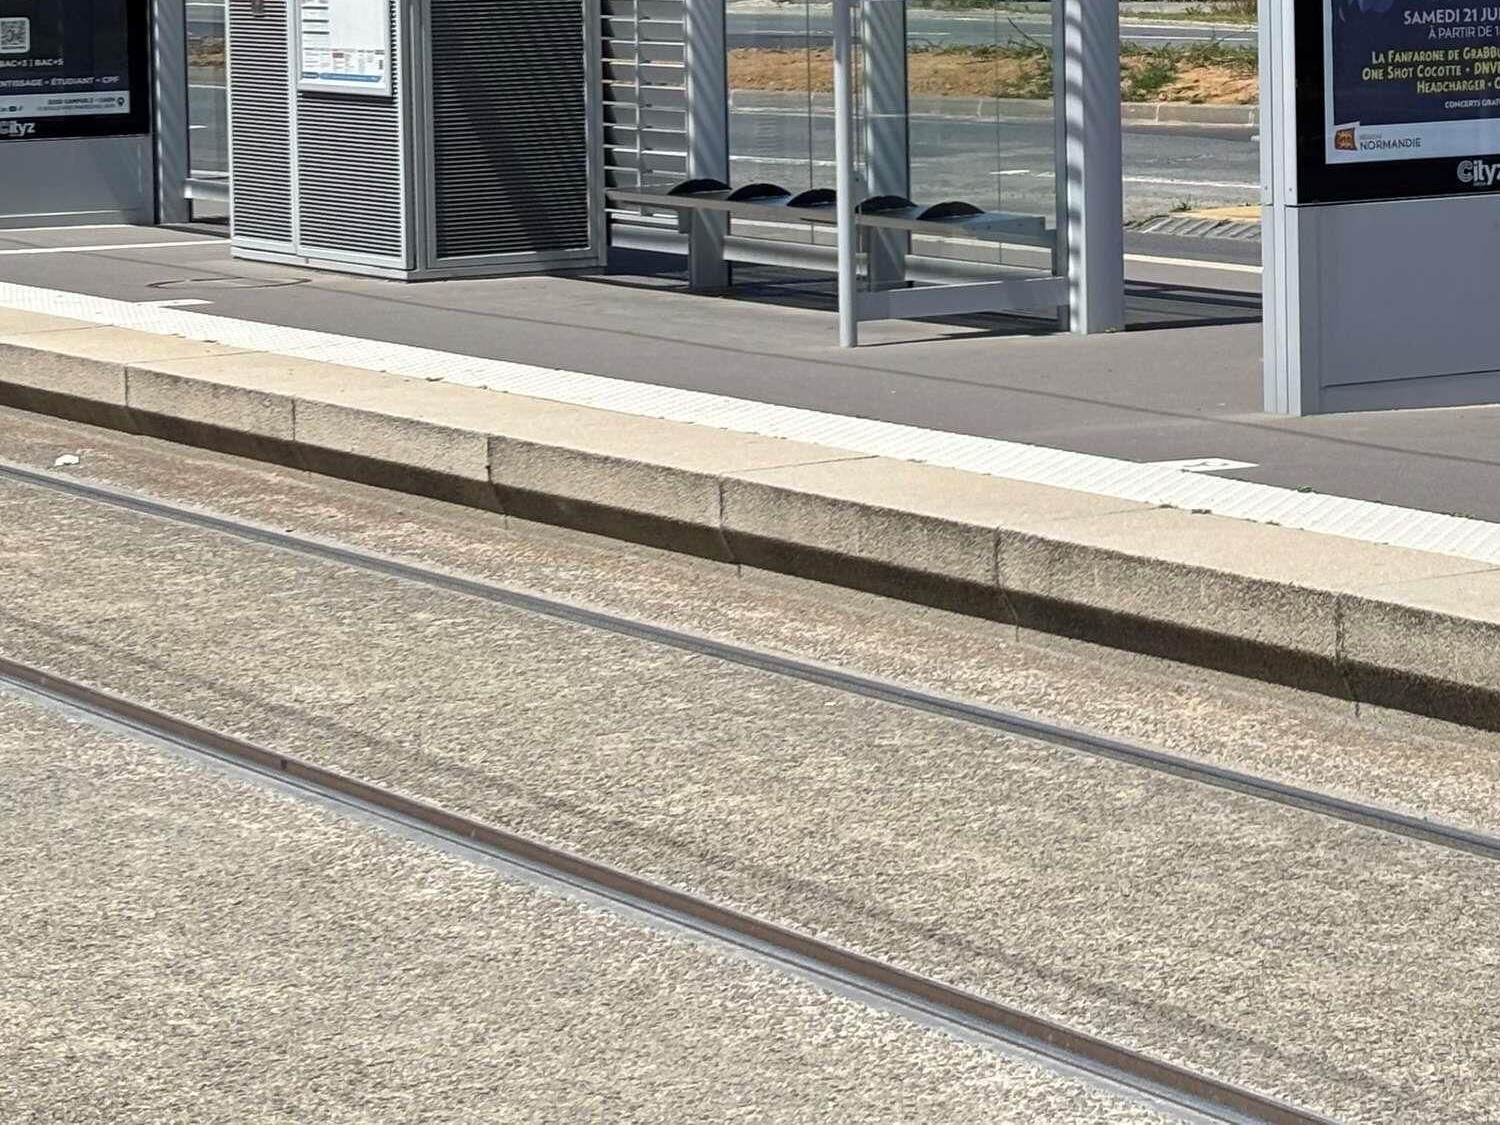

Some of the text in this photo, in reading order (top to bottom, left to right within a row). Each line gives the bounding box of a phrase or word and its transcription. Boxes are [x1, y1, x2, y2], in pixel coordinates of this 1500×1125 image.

[1403, 8, 1460, 25] SAMEDI
[1463, 7, 1477, 22] 21
[1428, 24, 1437, 40] À
[1438, 26, 1476, 39] PARTIR
[1477, 25, 1493, 38] DE
[1371, 50, 1386, 64] LA
[1447, 49, 1460, 61] DE
[1362, 67, 1384, 80] ONE
[1416, 64, 1462, 78] COCOTTE
[1360, 138, 1422, 151] NORMANDIE
